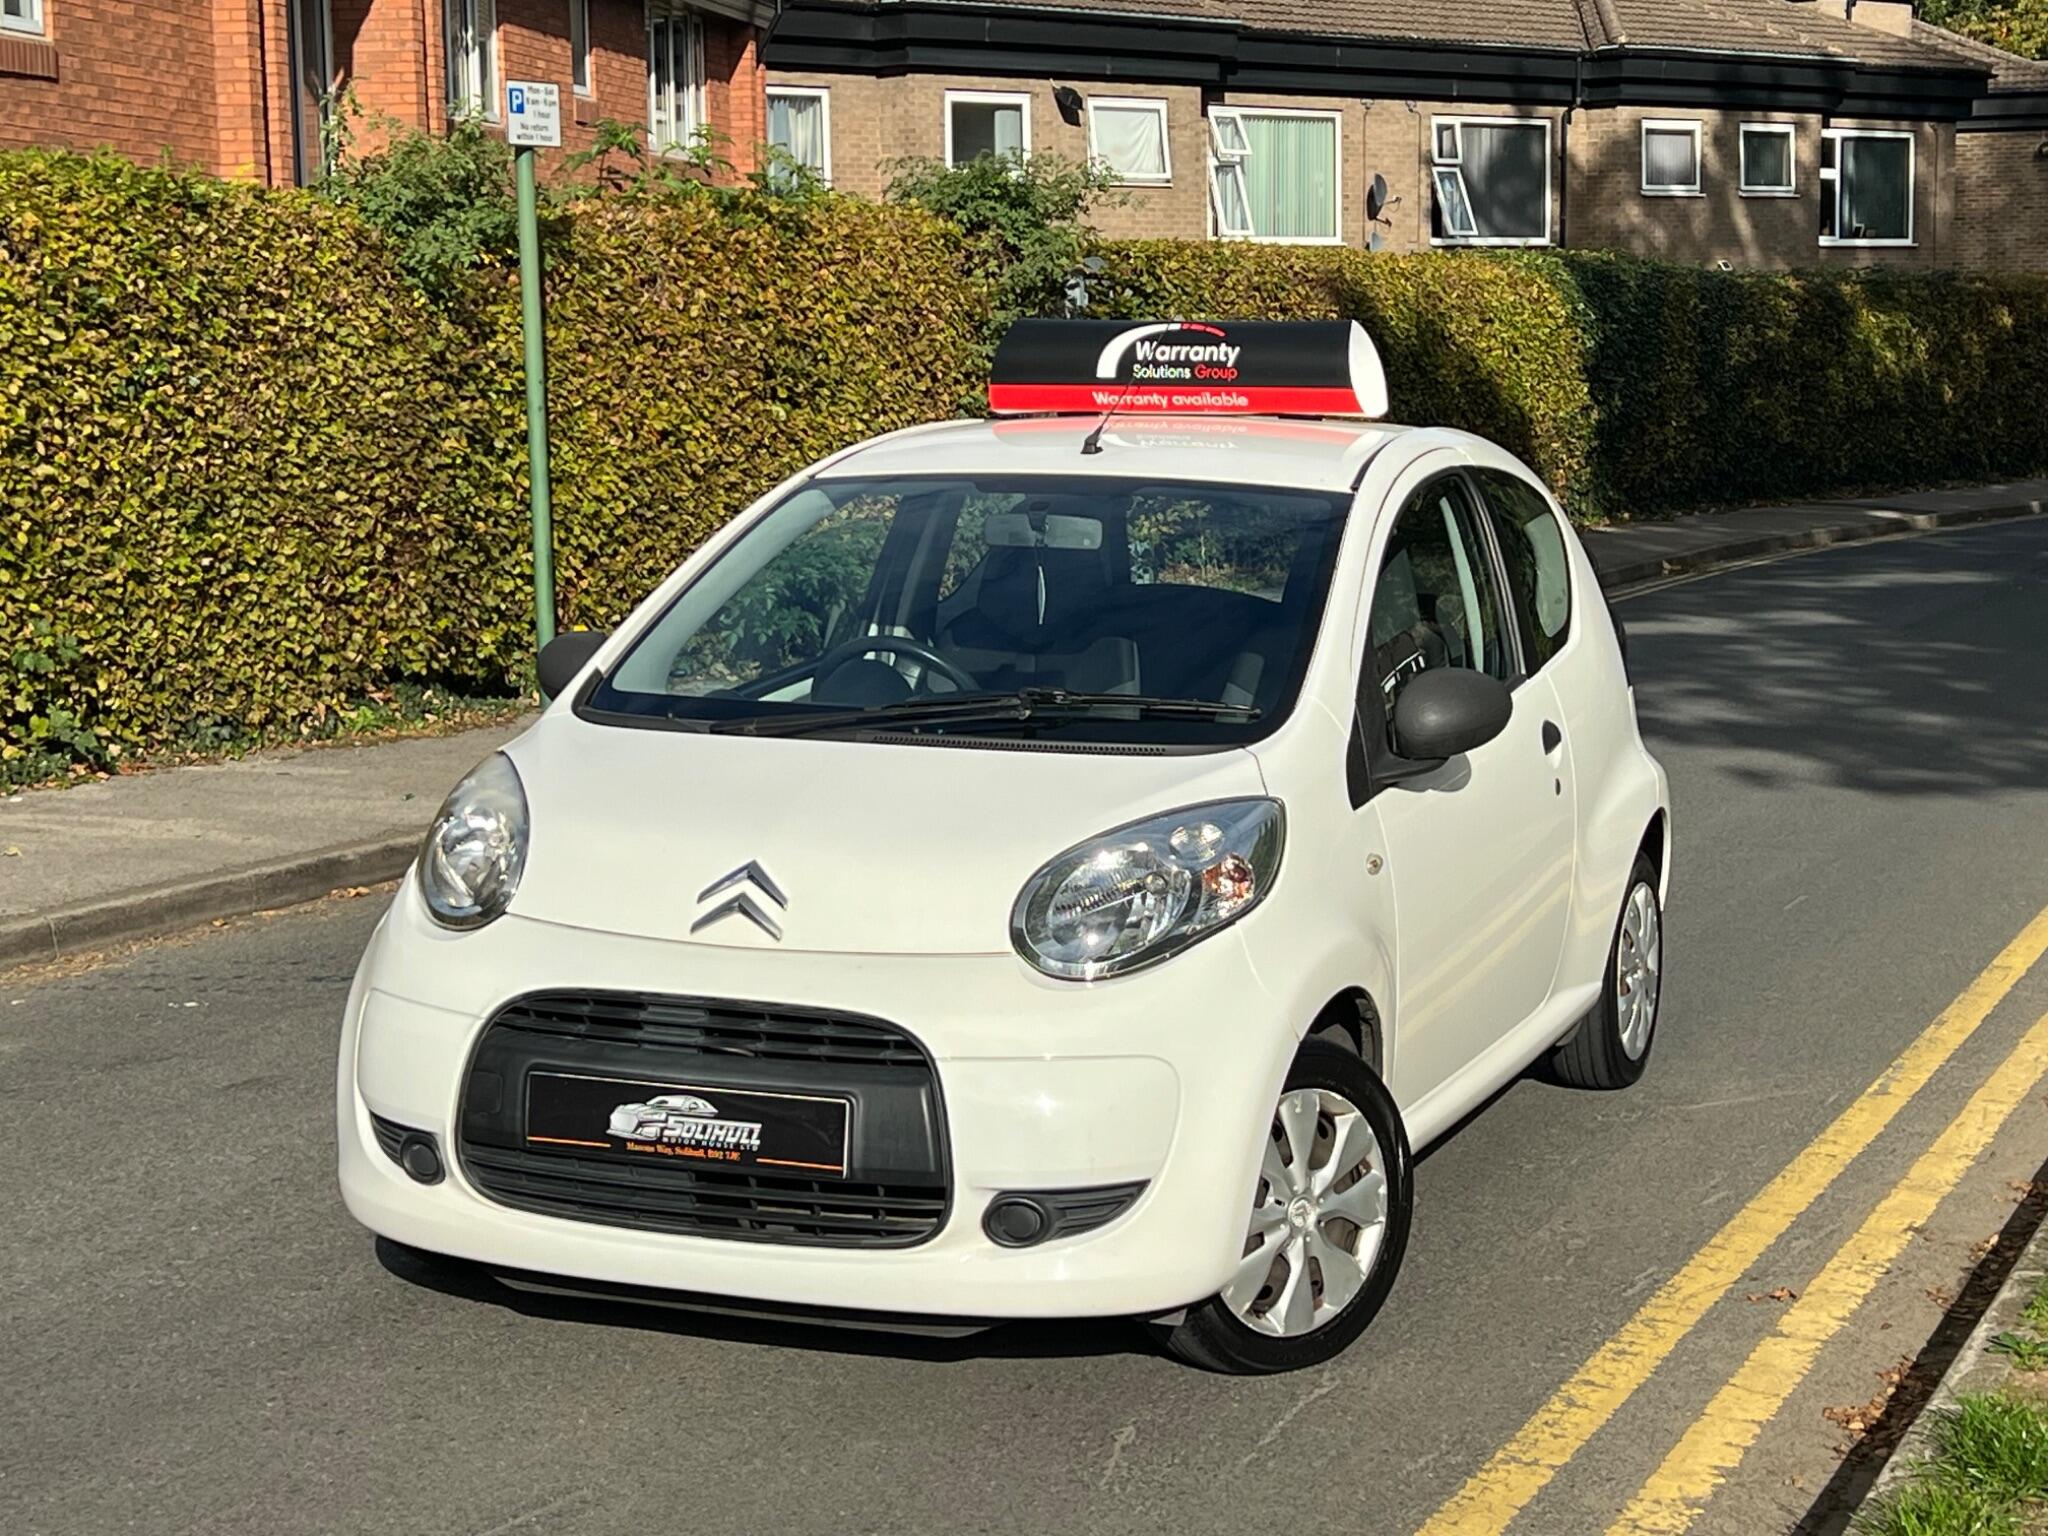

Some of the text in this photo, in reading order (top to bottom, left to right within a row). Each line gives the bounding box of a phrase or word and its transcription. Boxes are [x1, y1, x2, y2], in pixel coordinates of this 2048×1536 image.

[1135, 340, 1241, 367] Warranty
[1132, 363, 1238, 381] Solutions Group
[1092, 391, 1249, 408] Warranty available
[662, 1115, 762, 1145] SOLIHULL
[662, 1136, 759, 1152] MOTOR HOUSE LTD
